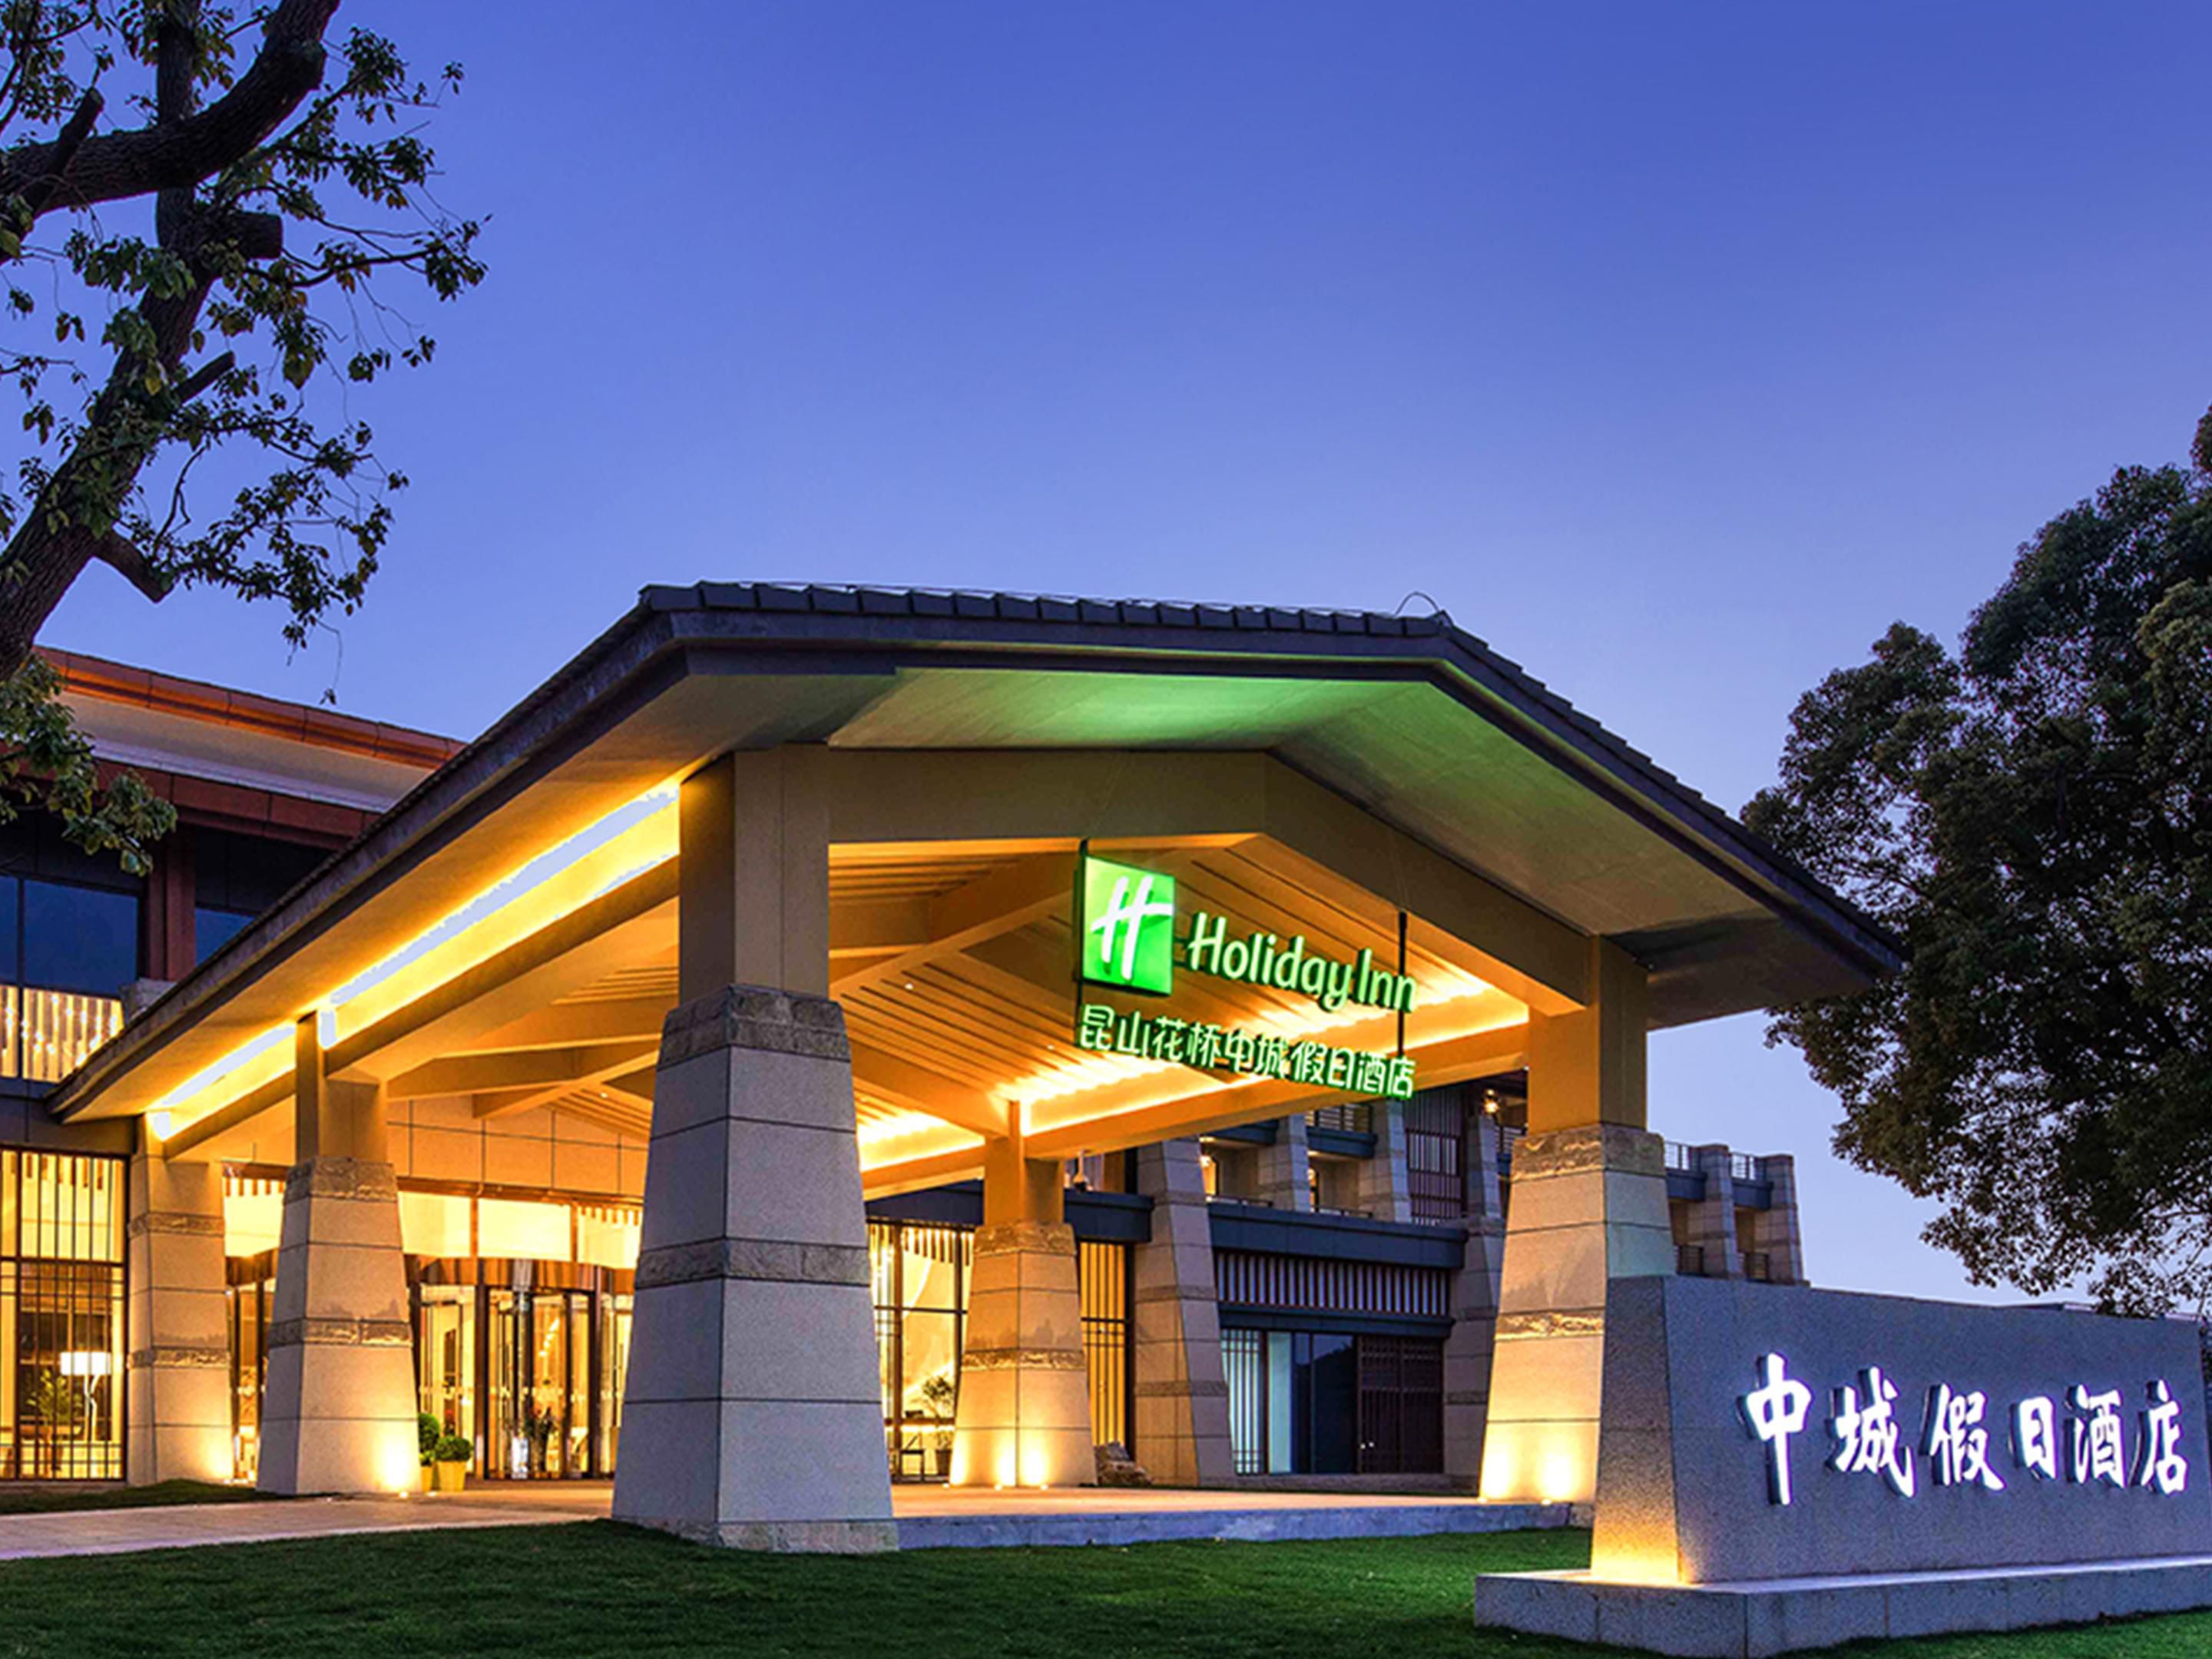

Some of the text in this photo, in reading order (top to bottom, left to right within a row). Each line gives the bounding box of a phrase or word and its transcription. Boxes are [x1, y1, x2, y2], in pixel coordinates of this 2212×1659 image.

[1187, 912, 1417, 1012] Holiday Inn
[1079, 1004, 1416, 1098] 昆山花桥中城假日酒店
[1745, 1353, 2188, 1505] 中城假日酒店
